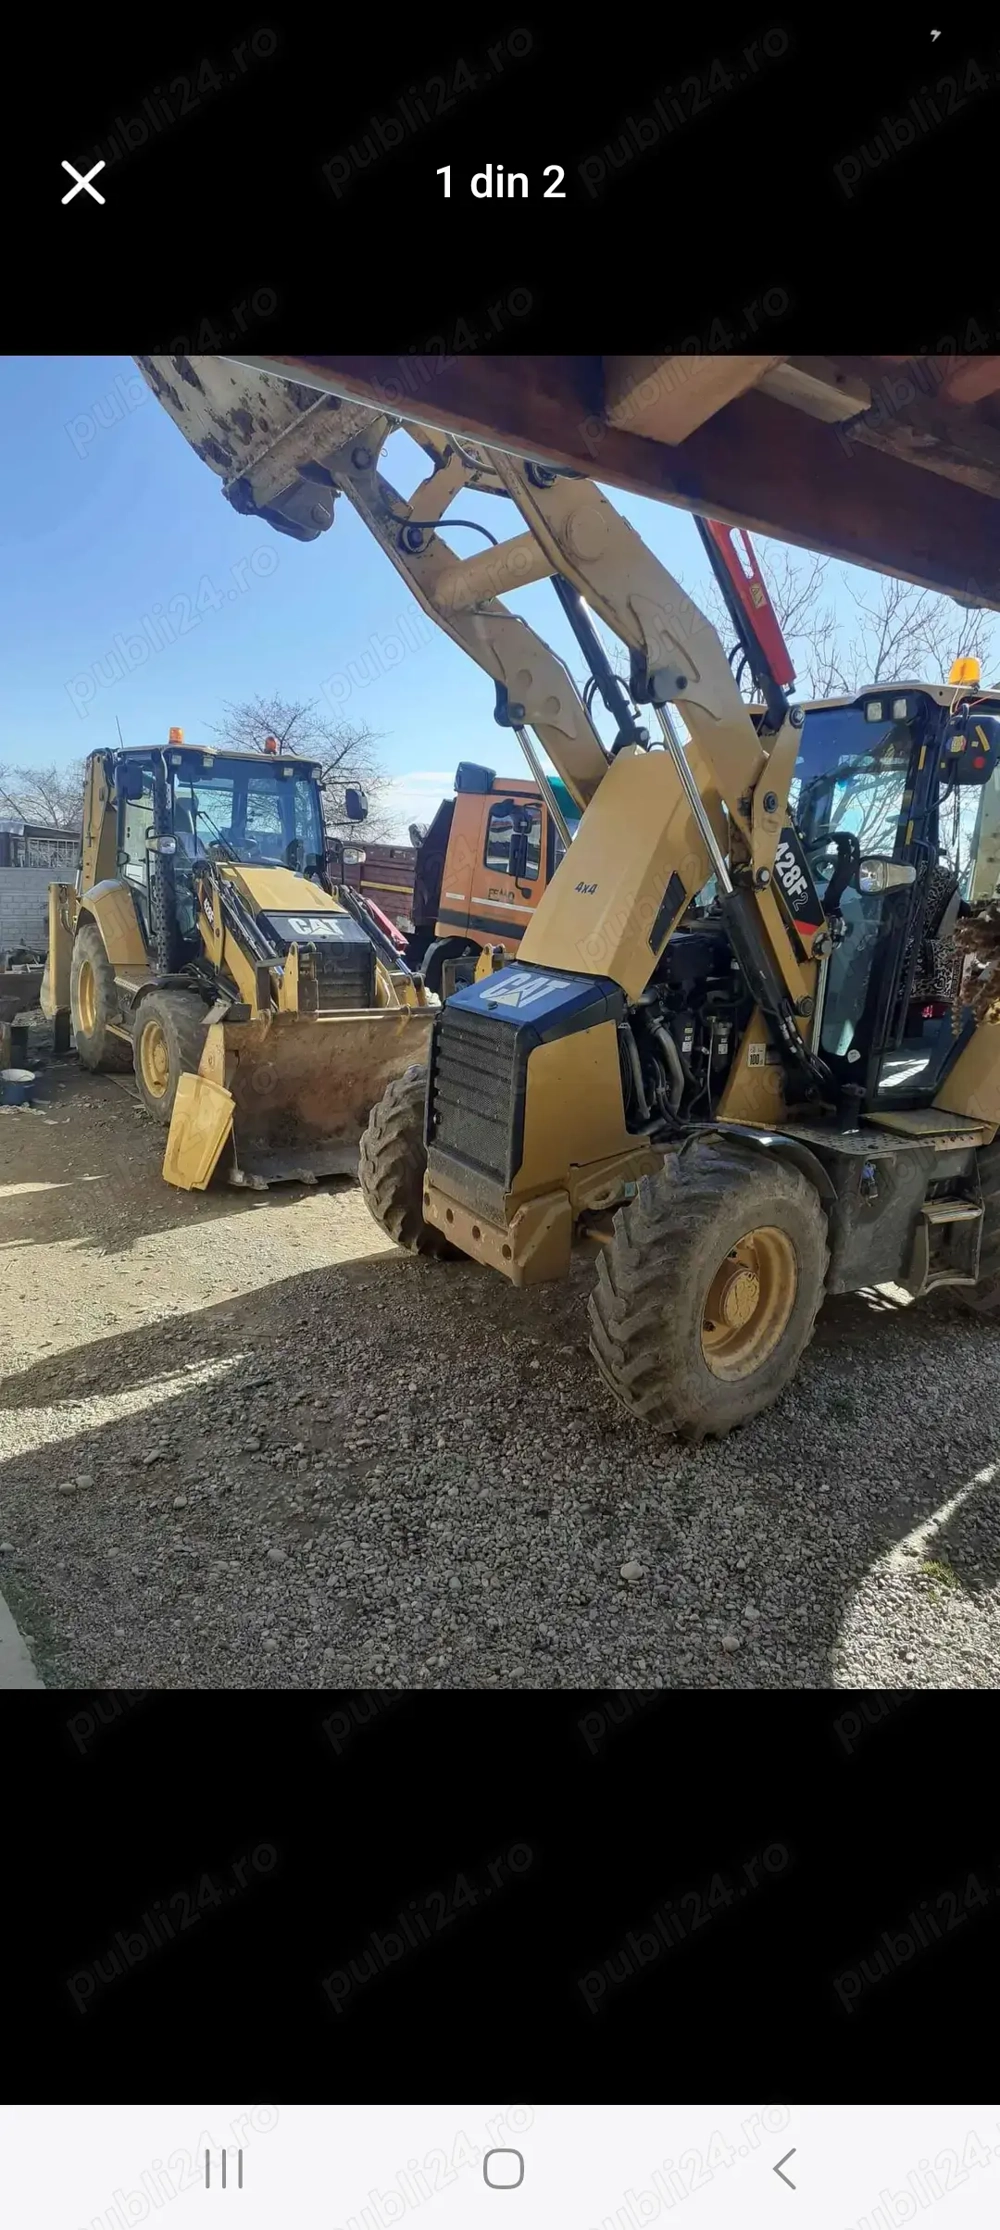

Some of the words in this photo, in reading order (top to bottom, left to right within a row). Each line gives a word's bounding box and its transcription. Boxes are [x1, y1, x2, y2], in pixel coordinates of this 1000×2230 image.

[436, 164, 450, 197] 1
[470, 163, 529, 198] din
[542, 164, 566, 197] 2
[575, 882, 598, 895] 4x4
[288, 918, 345, 936] CAT
[479, 973, 571, 1008] CAT
